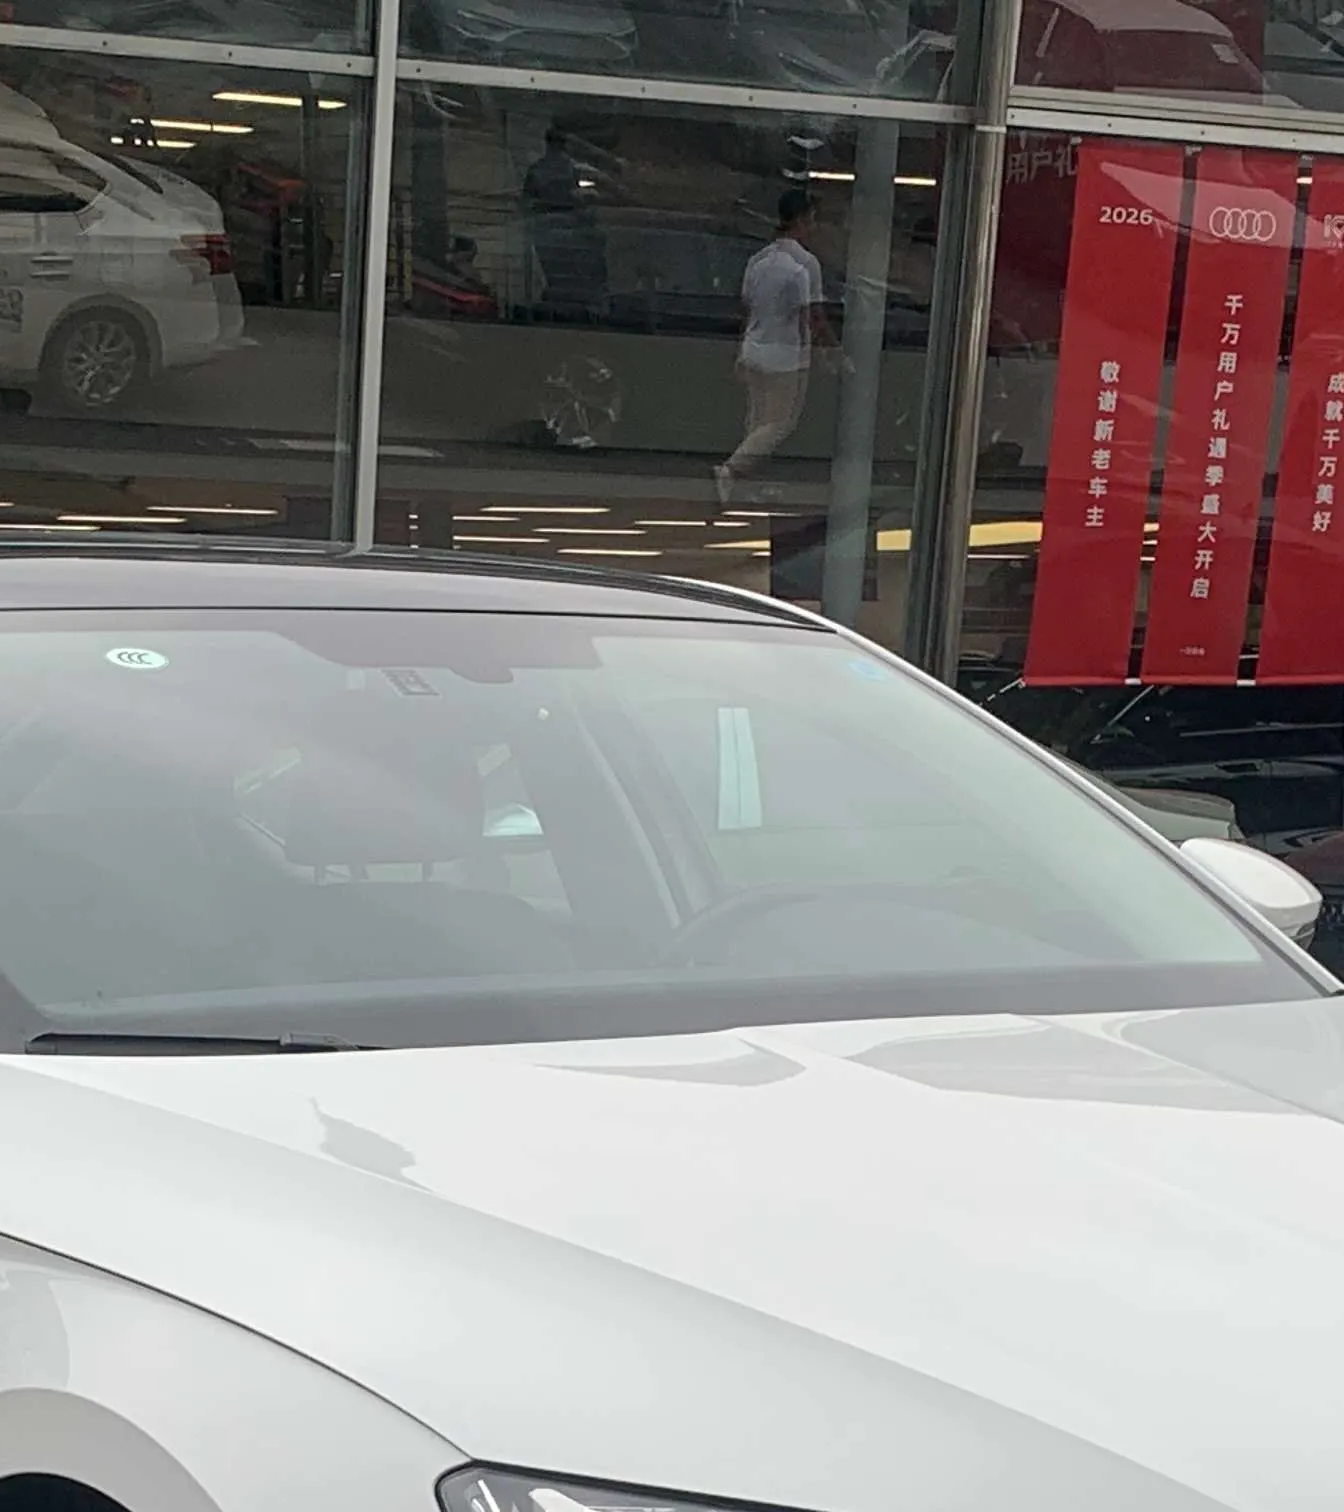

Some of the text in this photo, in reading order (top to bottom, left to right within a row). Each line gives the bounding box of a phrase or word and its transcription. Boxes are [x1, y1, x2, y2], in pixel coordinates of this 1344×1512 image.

[1100, 206, 1154, 226] 2026
[1084, 361, 1121, 528] 敬谢新老车主
[1189, 294, 1244, 599] 千万用户礼遇季盛大开启
